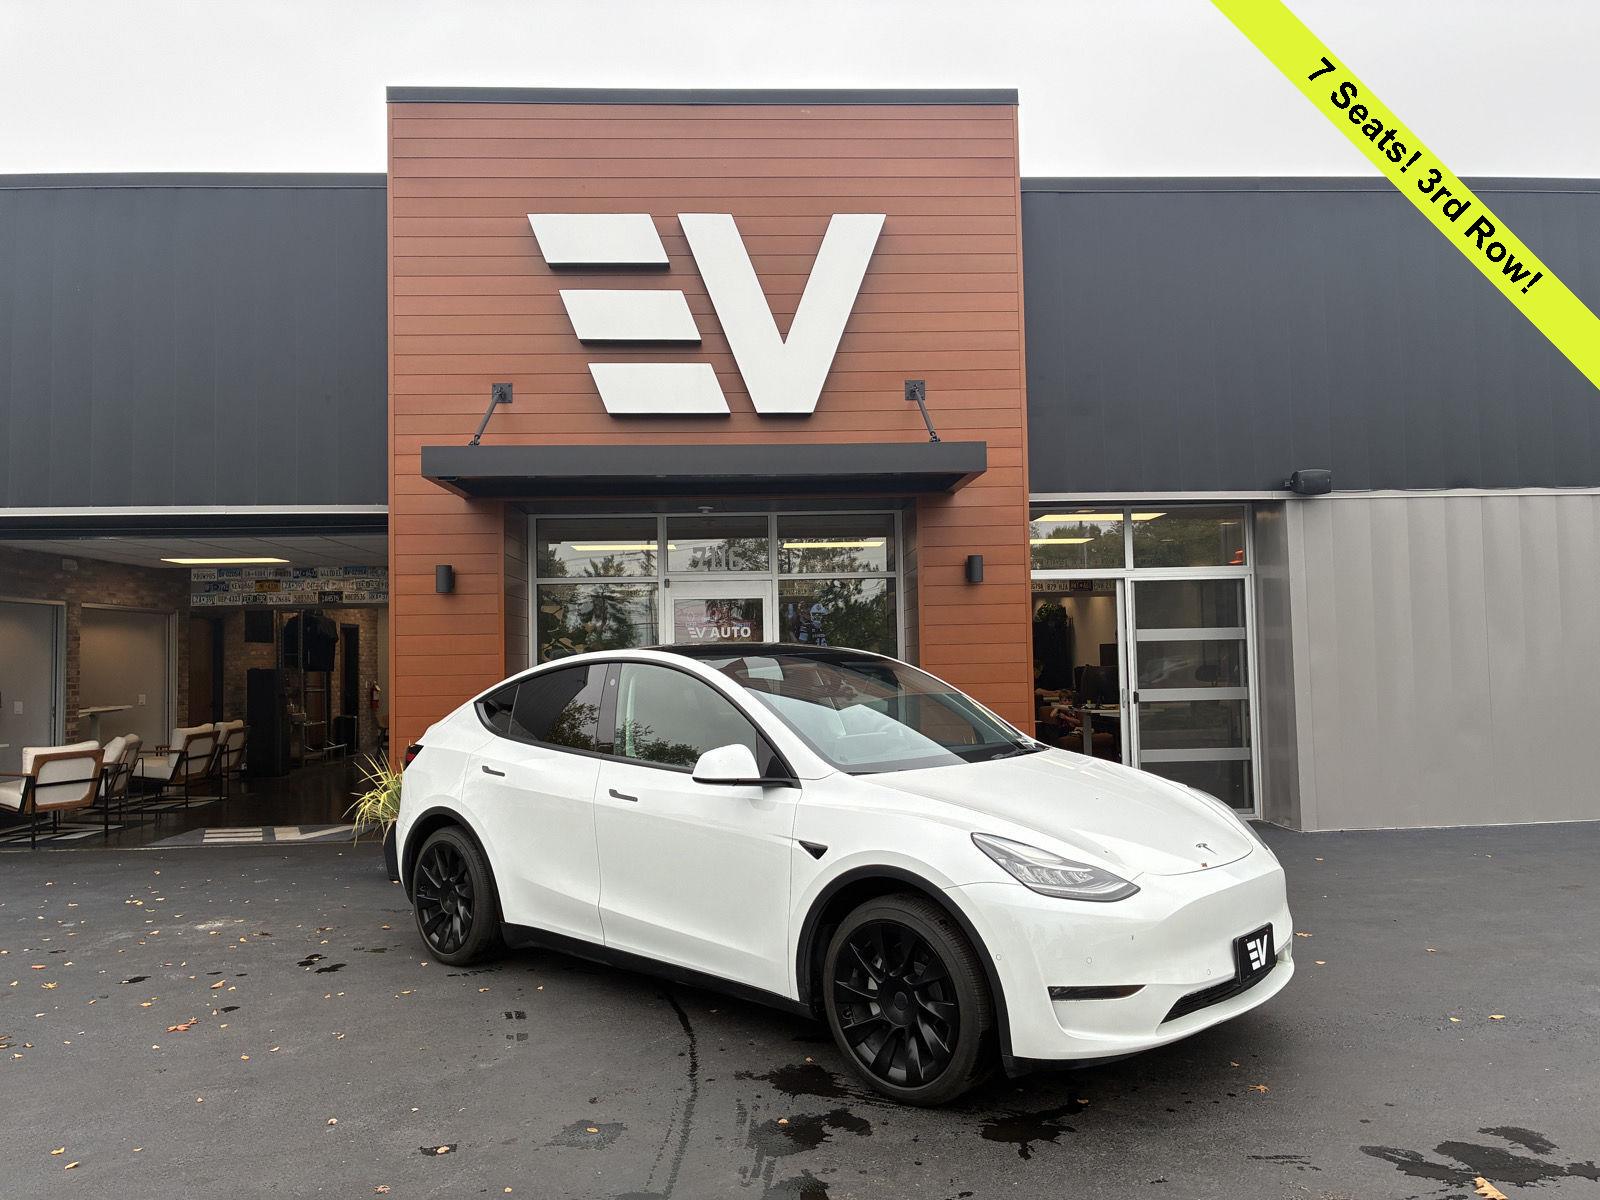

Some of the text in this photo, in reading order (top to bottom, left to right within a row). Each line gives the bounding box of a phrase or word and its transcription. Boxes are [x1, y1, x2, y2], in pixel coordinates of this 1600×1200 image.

[526, 213, 887, 415] EV
[687, 626, 752, 639] EV AUTO
[1246, 934, 1268, 971] EV
